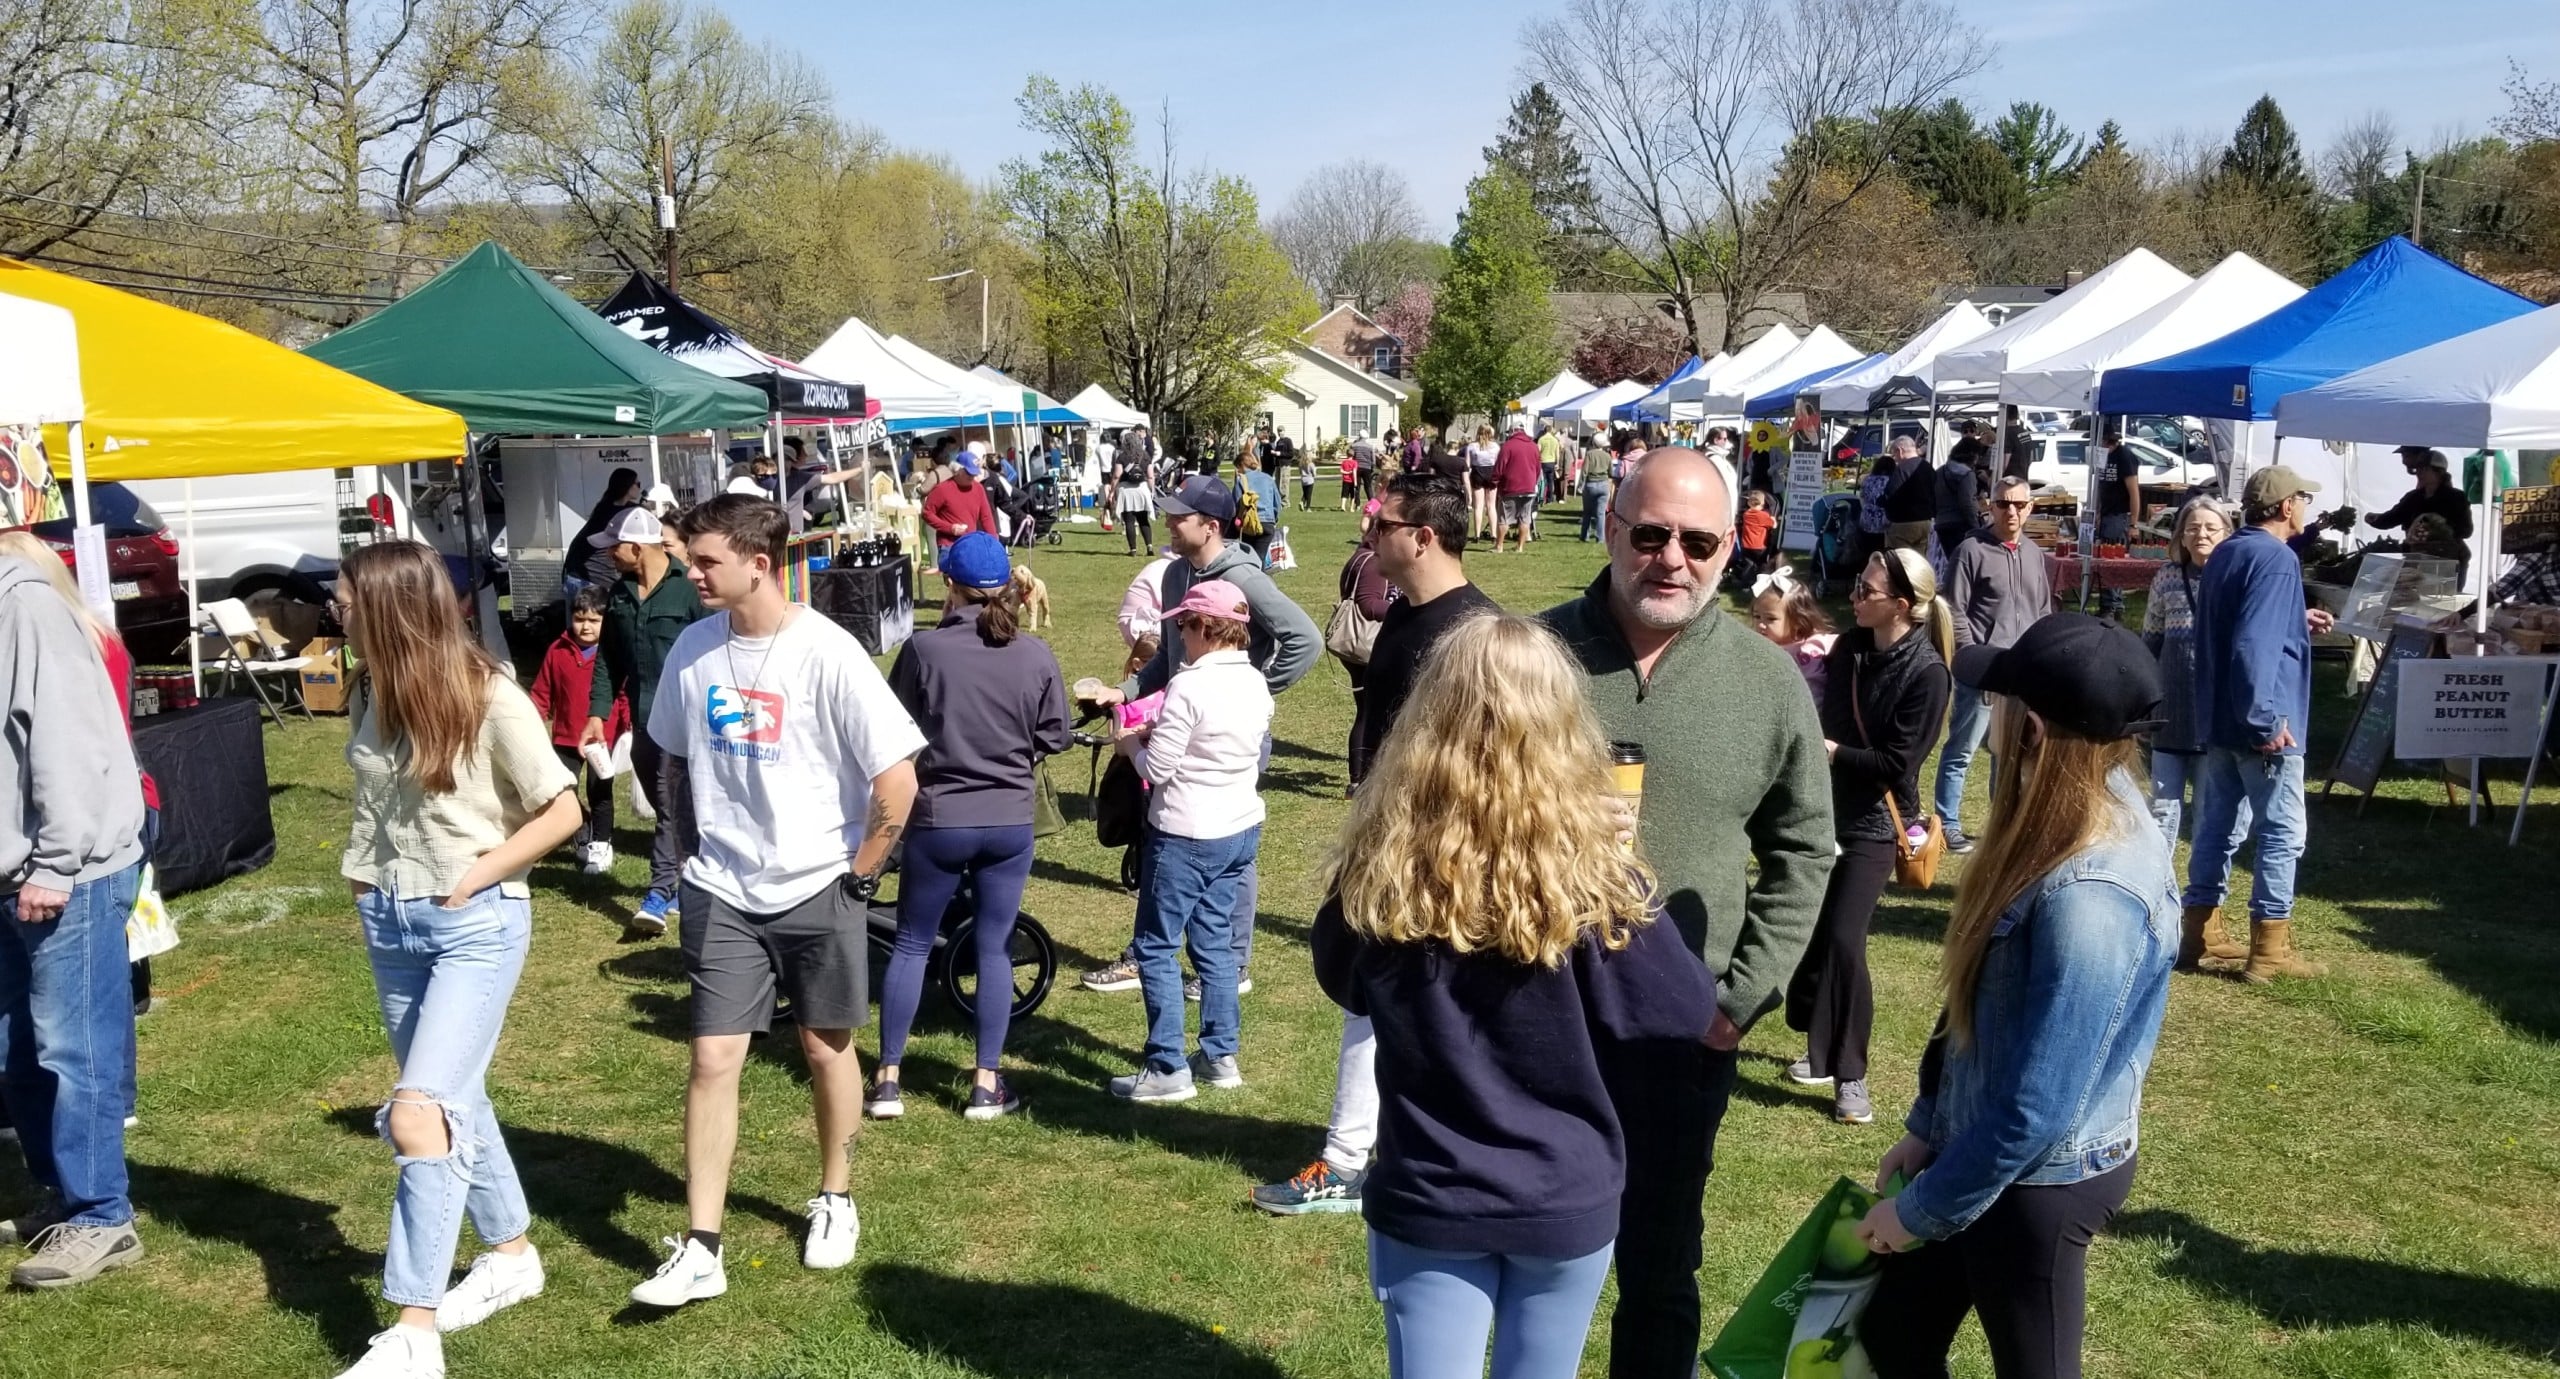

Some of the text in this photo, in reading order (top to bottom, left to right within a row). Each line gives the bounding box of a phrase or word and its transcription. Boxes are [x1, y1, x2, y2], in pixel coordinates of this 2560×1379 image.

[803, 382, 849, 410] KOMBUCHA
[2504, 487, 2560, 502] FRESH
[2503, 512, 2559, 525] BUTTER
[2444, 674, 2504, 686] FRESH
[2434, 691, 2510, 702] PEANUT
[2435, 707, 2507, 719] BUTTER
